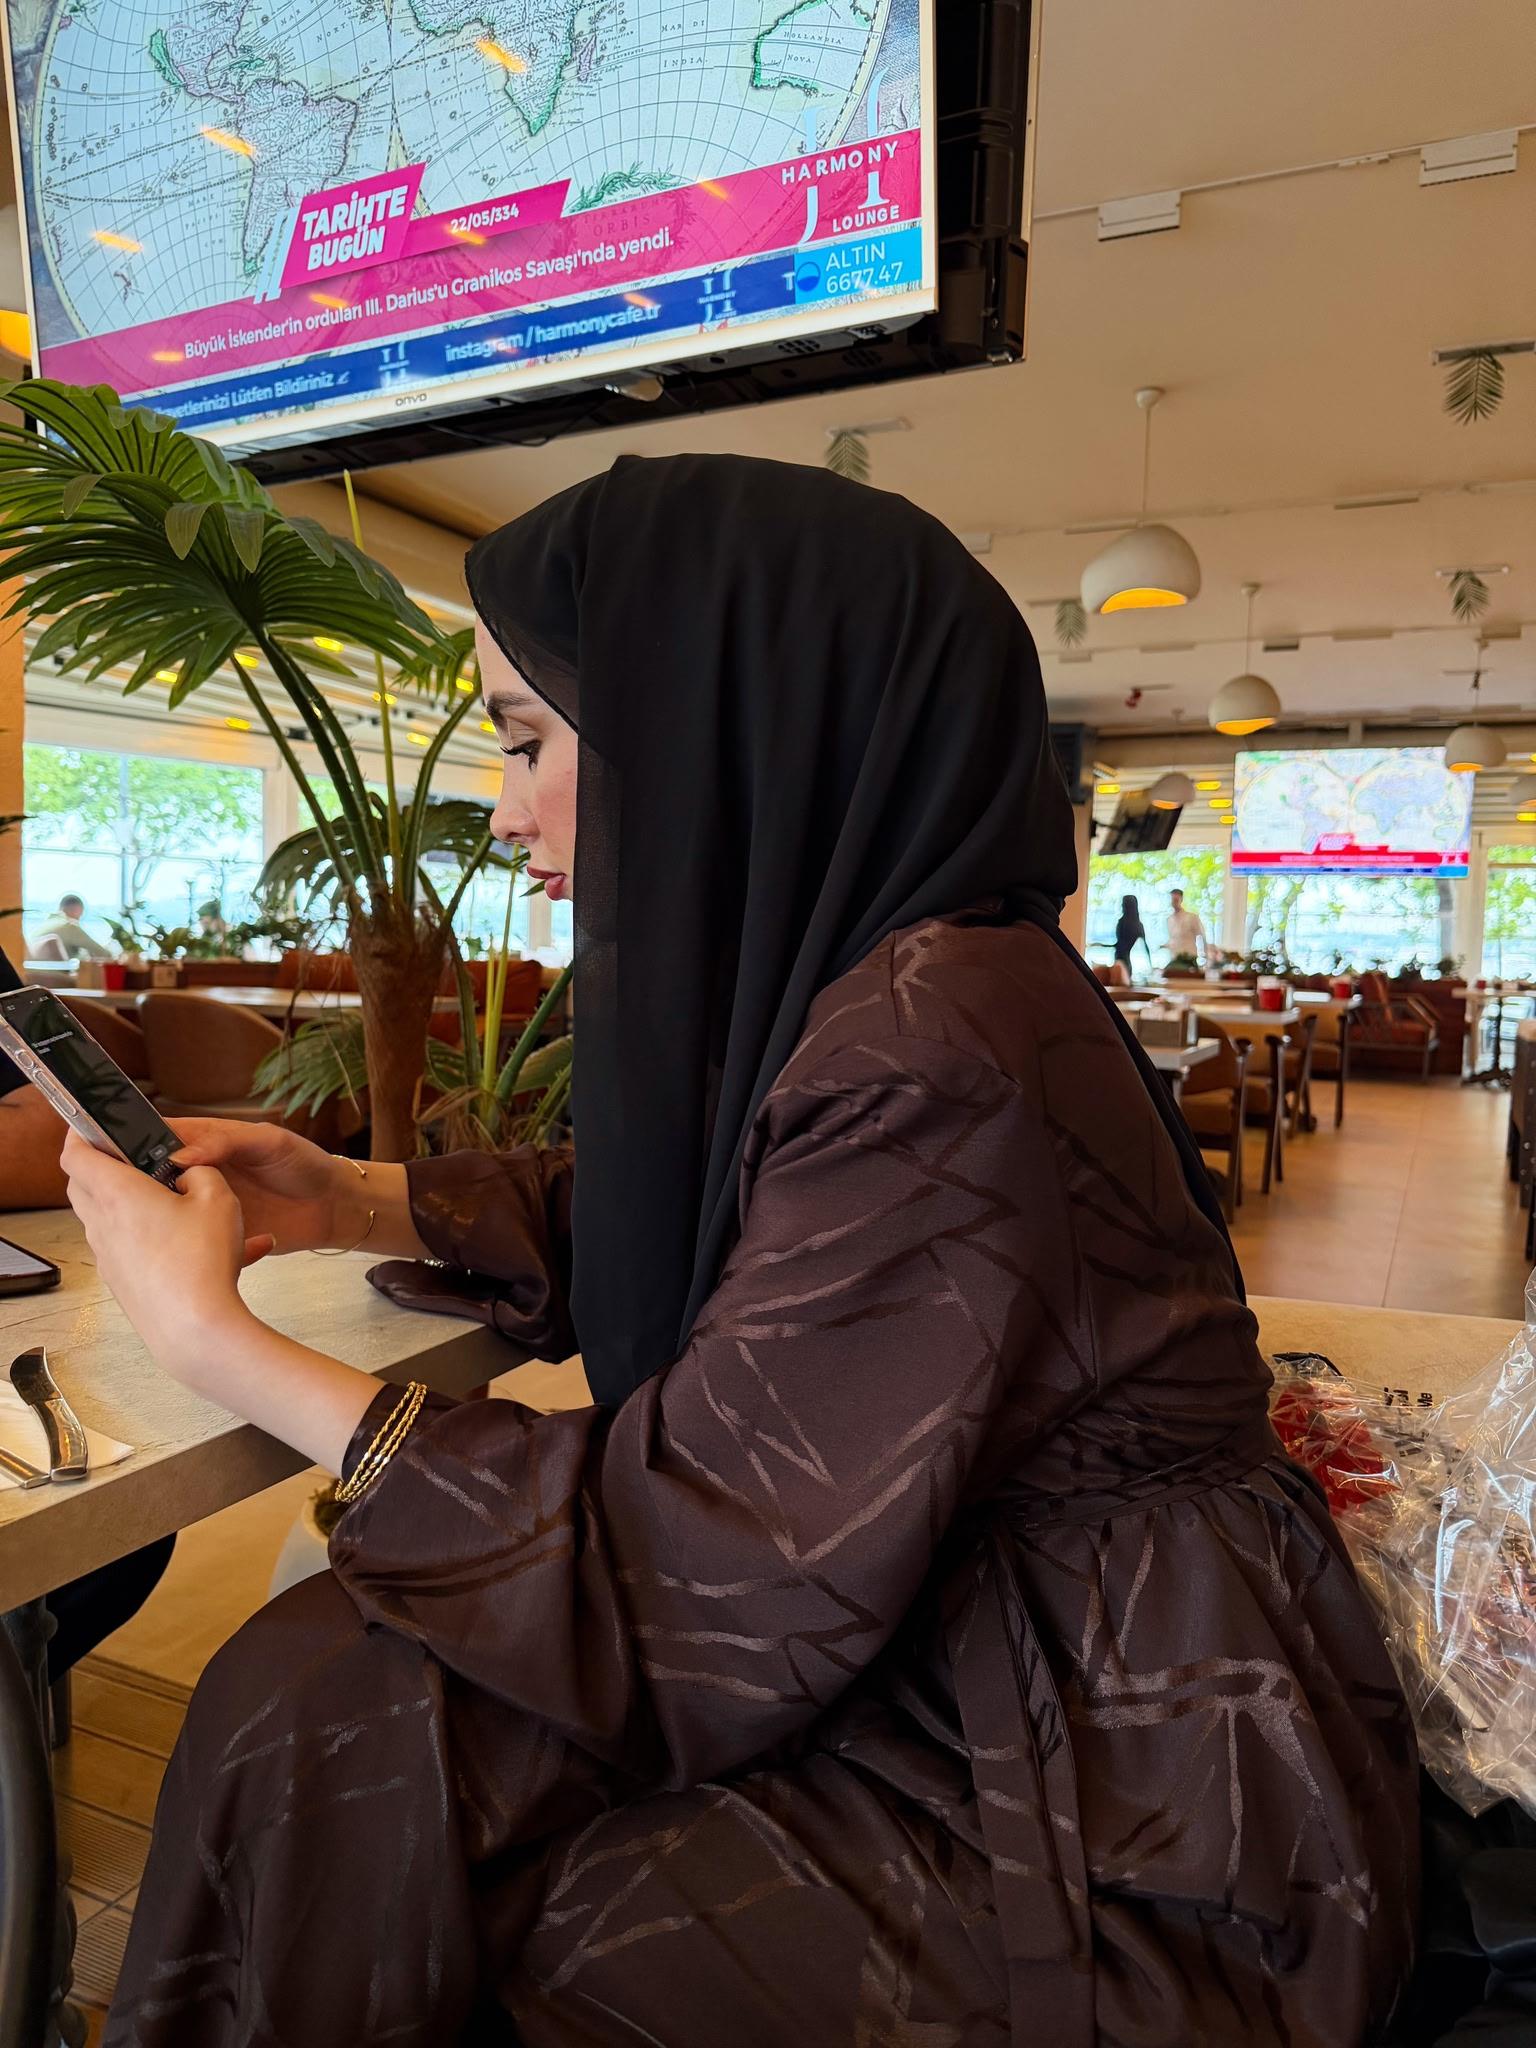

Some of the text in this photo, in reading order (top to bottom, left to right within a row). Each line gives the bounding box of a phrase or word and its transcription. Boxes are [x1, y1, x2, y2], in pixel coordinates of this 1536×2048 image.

[781, 140, 900, 185] HARMONY
[302, 185, 409, 241] TARİHTE
[450, 203, 520, 233] 22/05/334
[831, 205, 900, 233] LOUNGE
[307, 224, 386, 271] BUGÜN
[825, 241, 886, 271] ALTIN
[184, 226, 674, 359] Büyük İskender'in orduları III. Darius'u Granikos Savaşı'nda yendi.
[826, 261, 903, 294] 6677.47
[231, 384, 273, 407] Lütfen
[274, 371, 335, 399] Bildiriniz
